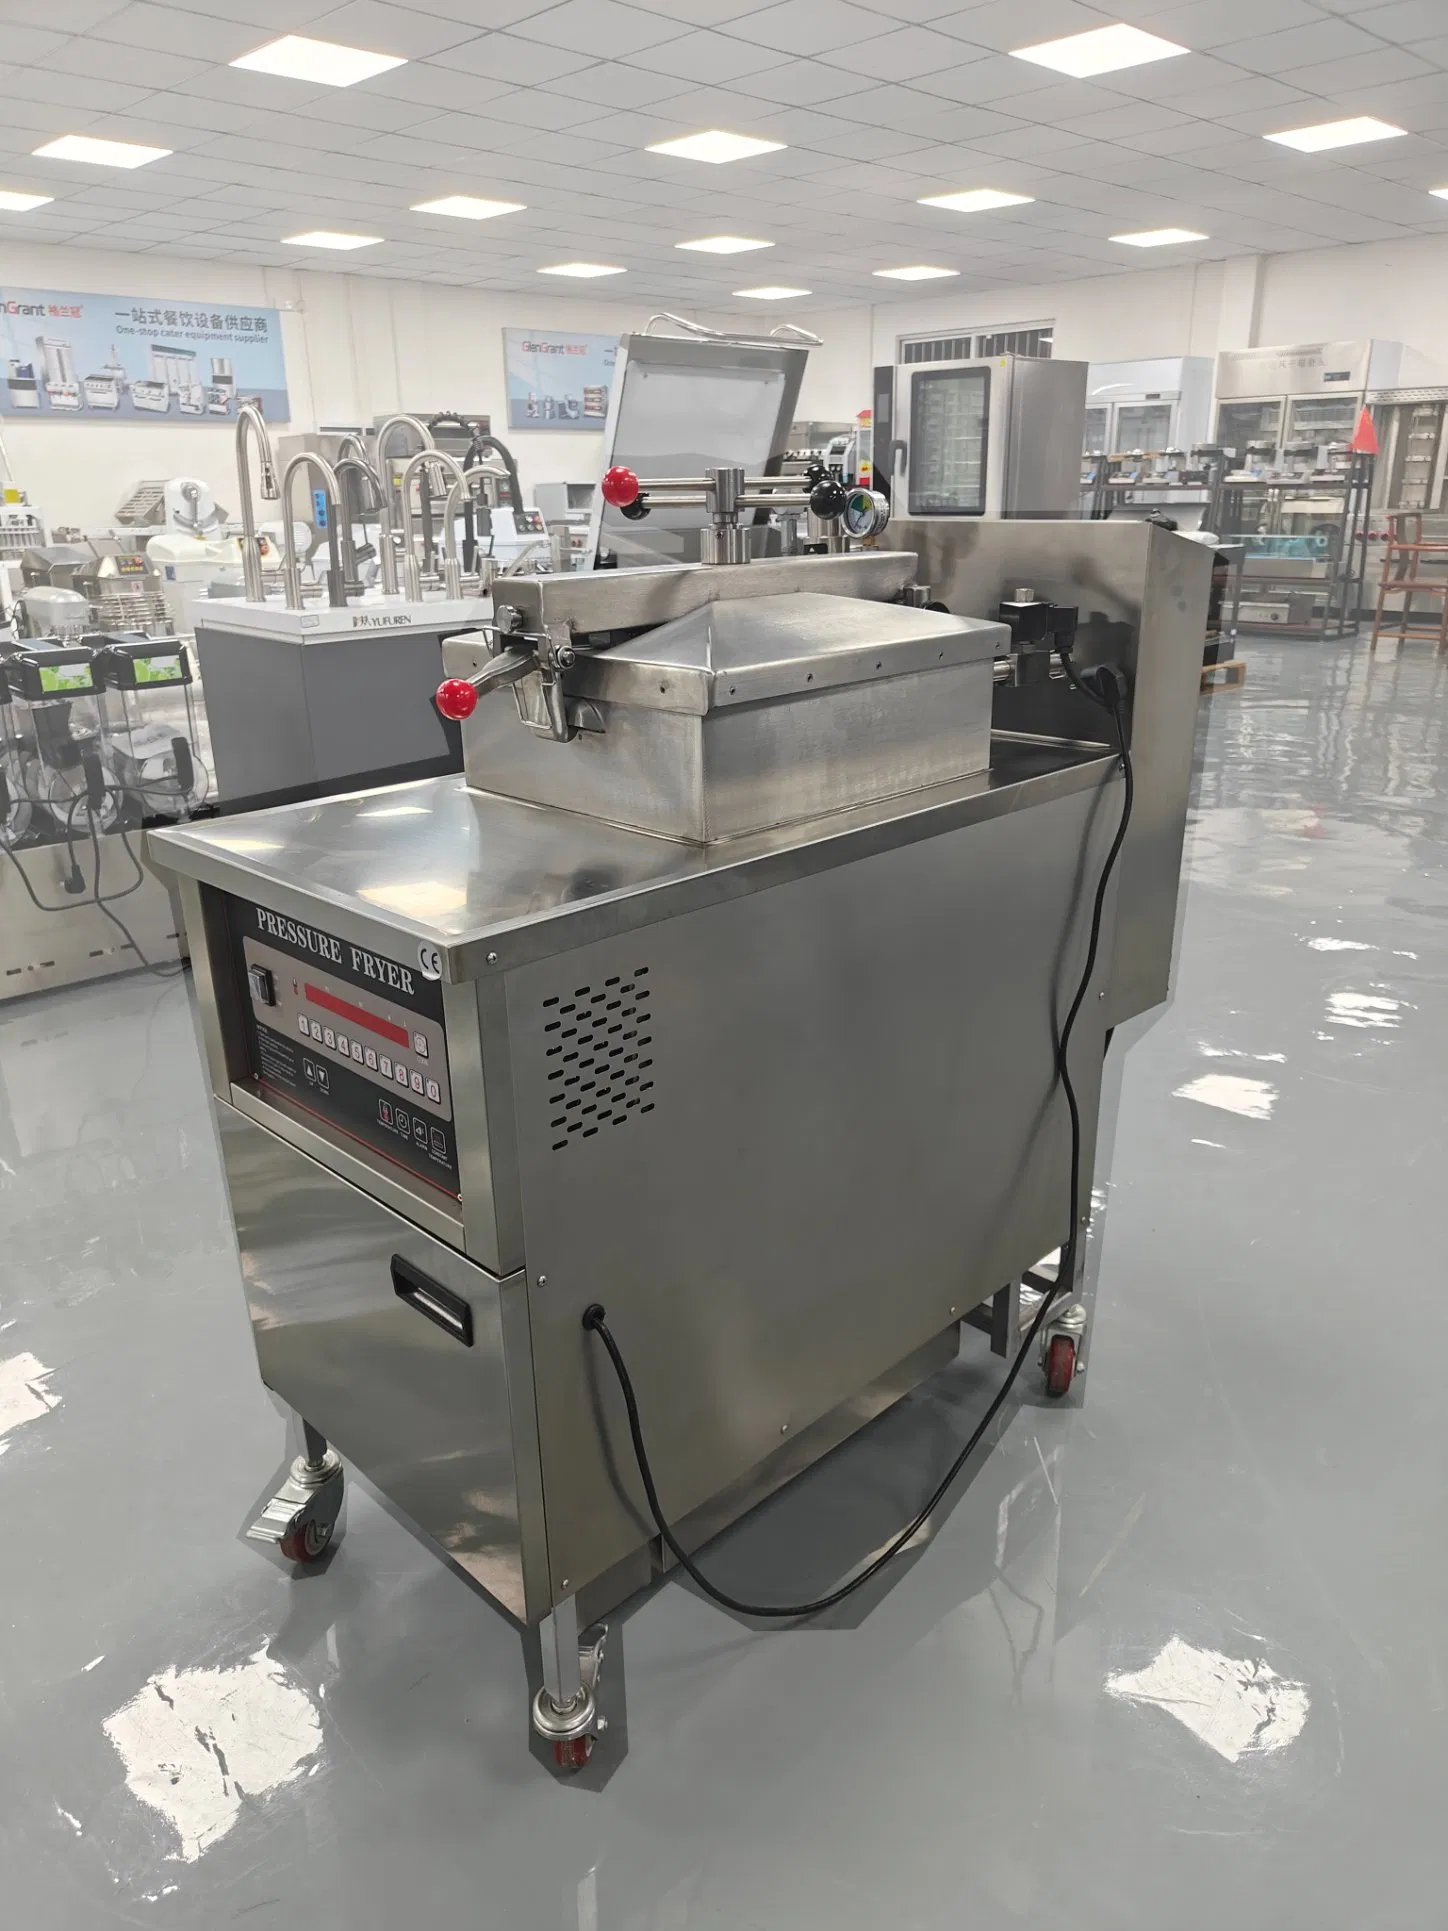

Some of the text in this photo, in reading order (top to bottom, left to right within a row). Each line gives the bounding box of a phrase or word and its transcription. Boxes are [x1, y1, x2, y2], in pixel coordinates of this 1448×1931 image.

[114, 307, 268, 333] 一站式餐饮设备供应商
[116, 325, 269, 343] One-stop cater equipment supplier
[371, 615, 412, 626] YUFUREN
[256, 908, 415, 995] PRESSURE FRYER
[420, 948, 440, 974] CE
